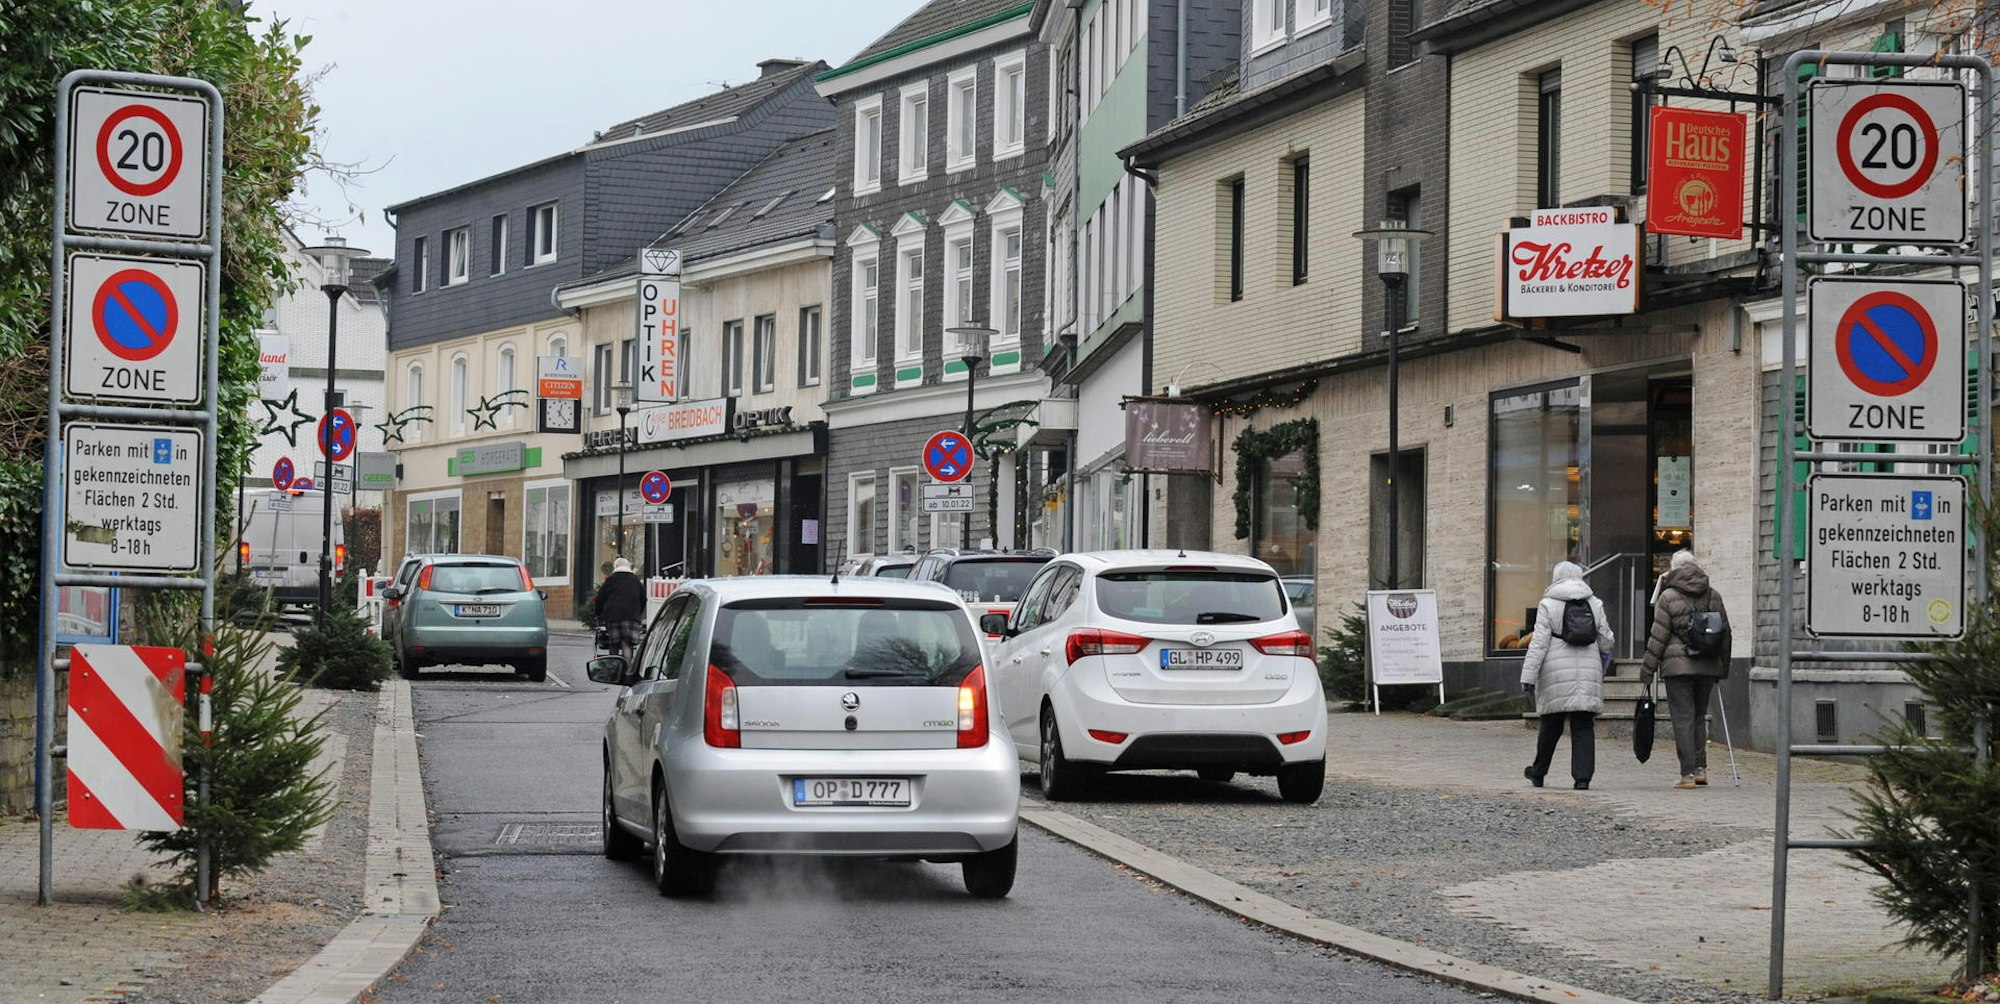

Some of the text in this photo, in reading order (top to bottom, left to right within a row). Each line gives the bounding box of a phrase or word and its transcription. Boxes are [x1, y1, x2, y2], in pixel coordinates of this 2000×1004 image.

[1687, 123, 1731, 136] Deutsches
[117, 129, 164, 172] 20
[1666, 122, 1730, 162] Haus
[1861, 122, 1917, 170] 20
[106, 201, 170, 226] ZONE
[1537, 212, 1608, 227] BACKBISTRO
[1850, 206, 1926, 231] ZONE
[1512, 241, 1634, 288] Kretzer
[1520, 282, 1616, 294] BÄCKEREI & KONDITOREI
[642, 284, 658, 382] OPTIK
[260, 352, 287, 363] land
[660, 298, 677, 398] UHREN
[101, 366, 166, 391] ZONE
[668, 405, 722, 430] BREIDBACH
[1848, 404, 1926, 430] ZONE
[1142, 429, 1196, 444] liebevoll
[76, 439, 188, 460] Parken mit in
[74, 466, 190, 486] gekennzeichneten
[85, 490, 178, 509] Flächen 2 Std.
[928, 500, 971, 508] ab 10.01.22
[1820, 493, 1950, 514] Parken mit in
[101, 516, 162, 536] werktags
[1819, 524, 1955, 546] gekennzeichneten
[1832, 550, 1942, 570] Flächen 2 Std.
[1851, 578, 1922, 601] werktags
[462, 606, 498, 614] K NA 710
[1380, 624, 1428, 632] ANGEBOTE
[1170, 652, 1240, 664] GL HP 499
[814, 781, 901, 798] OP D 777
